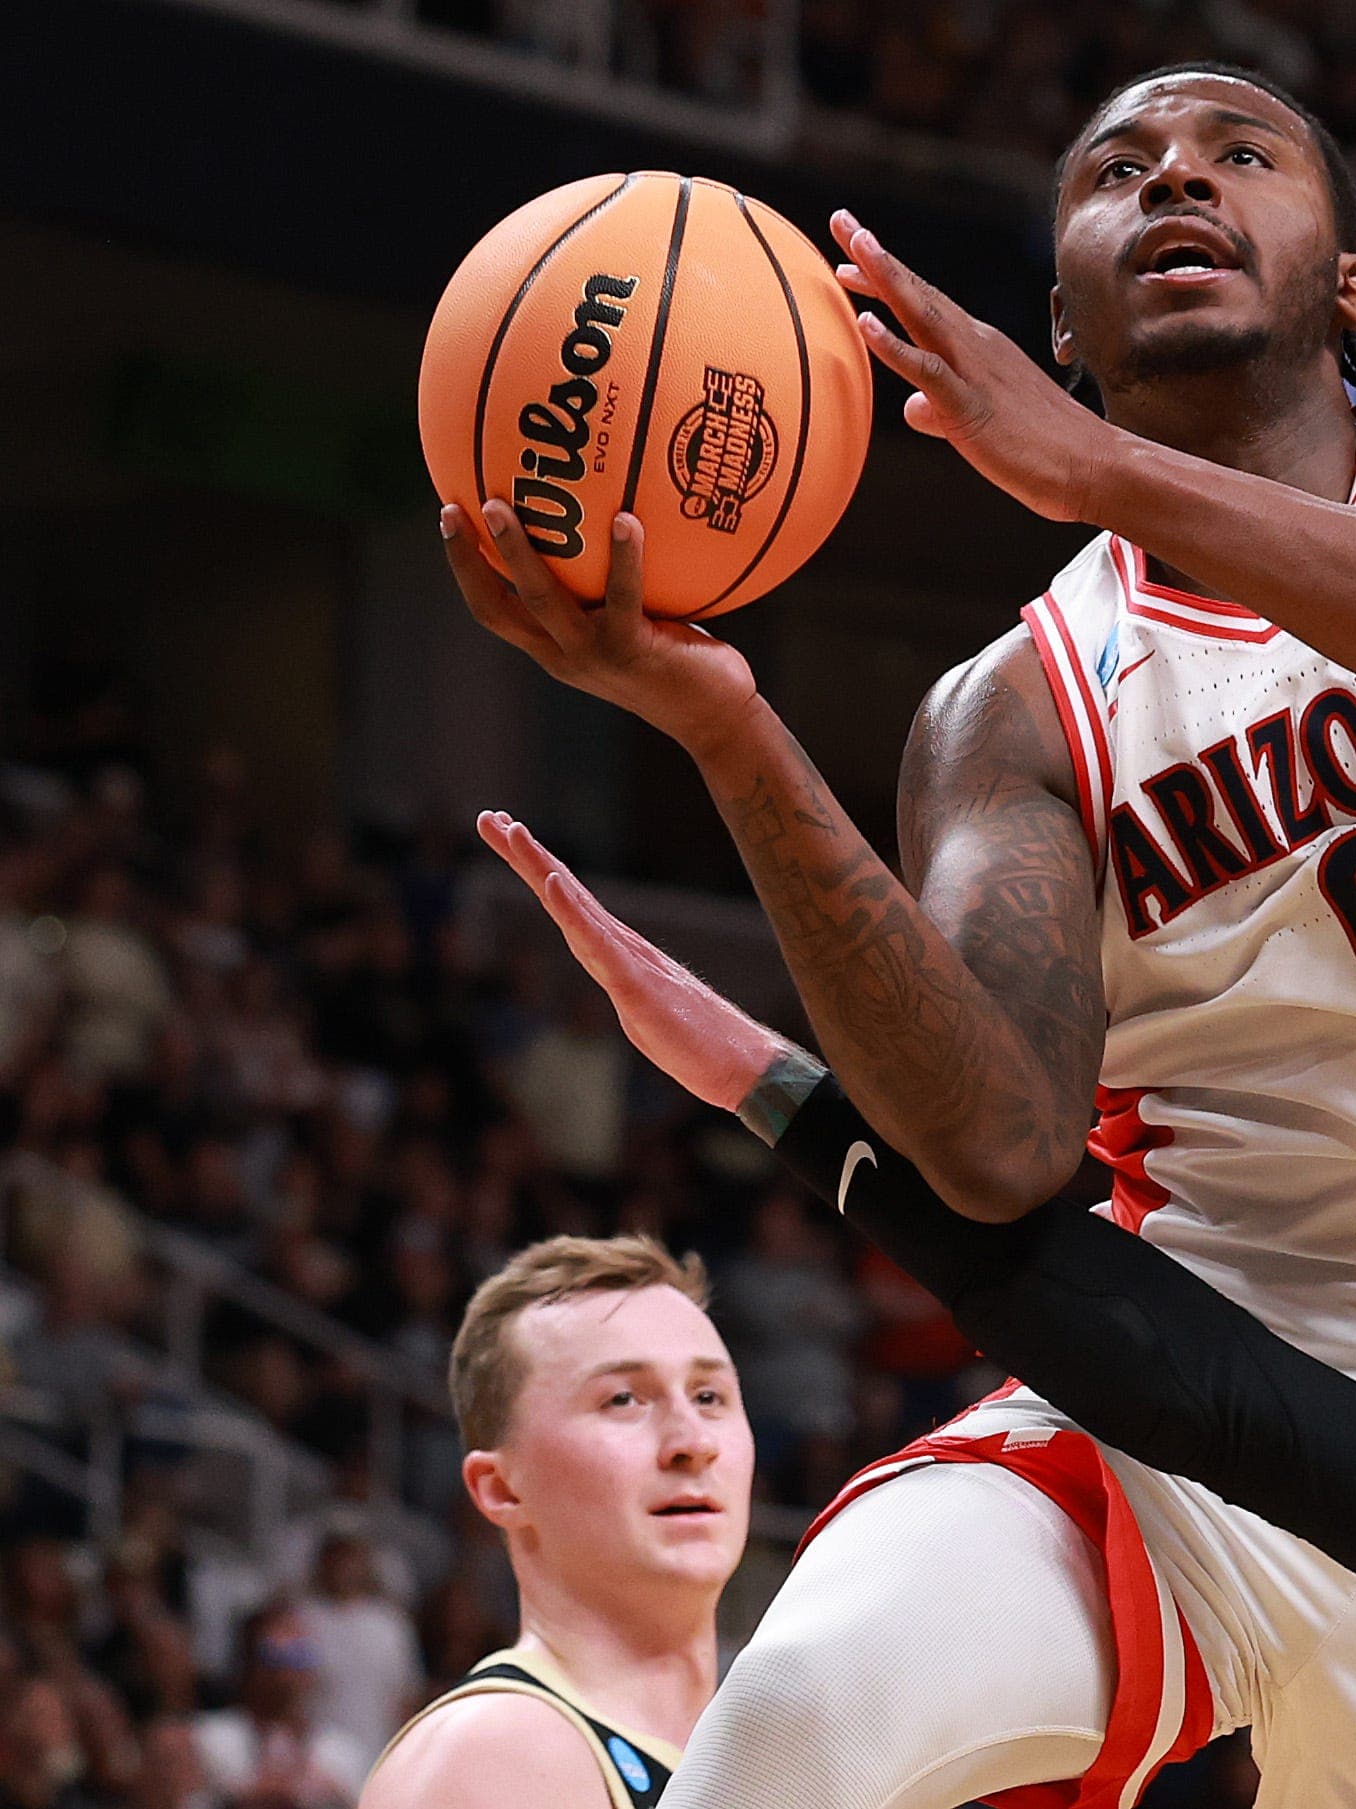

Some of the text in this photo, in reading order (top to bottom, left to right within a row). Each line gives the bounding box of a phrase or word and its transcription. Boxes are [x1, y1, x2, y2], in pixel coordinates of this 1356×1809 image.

[511, 273, 639, 559] Wilson
[593, 381, 620, 473] EVO NXT
[691, 412, 728, 498] MARCH
[717, 375, 756, 491] MADNESS
